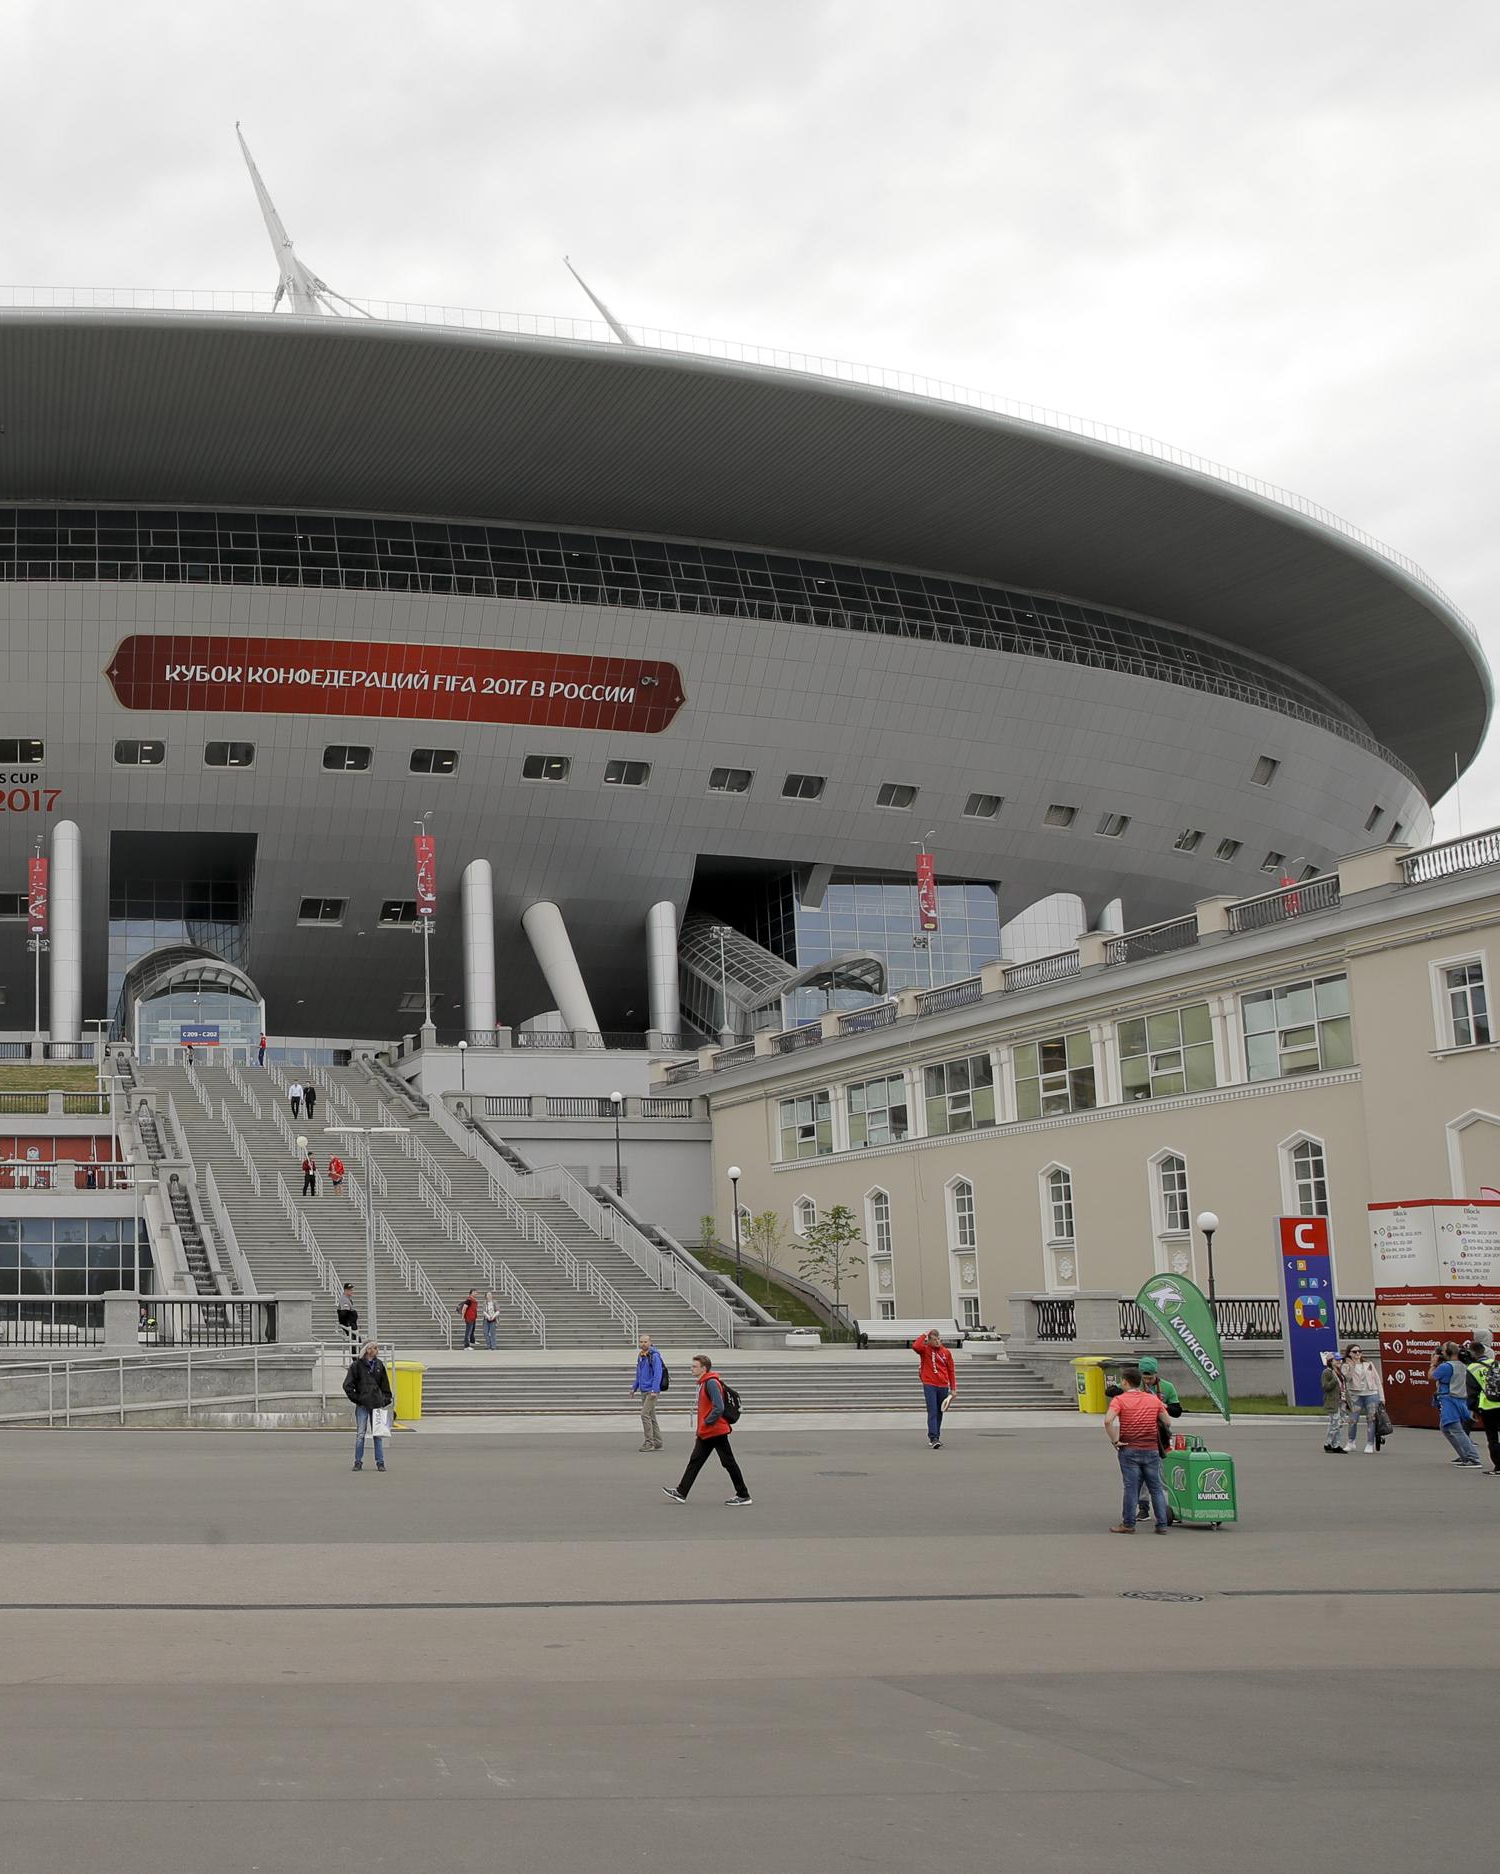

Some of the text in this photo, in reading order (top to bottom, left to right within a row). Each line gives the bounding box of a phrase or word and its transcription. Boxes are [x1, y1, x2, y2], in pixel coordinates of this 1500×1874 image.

[165, 664, 636, 704] КУБОК КОНФЕДЕРАЦИЙ FIFA 2017 В РОССИИ
[10, 773, 39, 784] CUP
[1294, 1223, 1315, 1249] C
[1170, 1316, 1220, 1380] КЛИНСКОЕ
